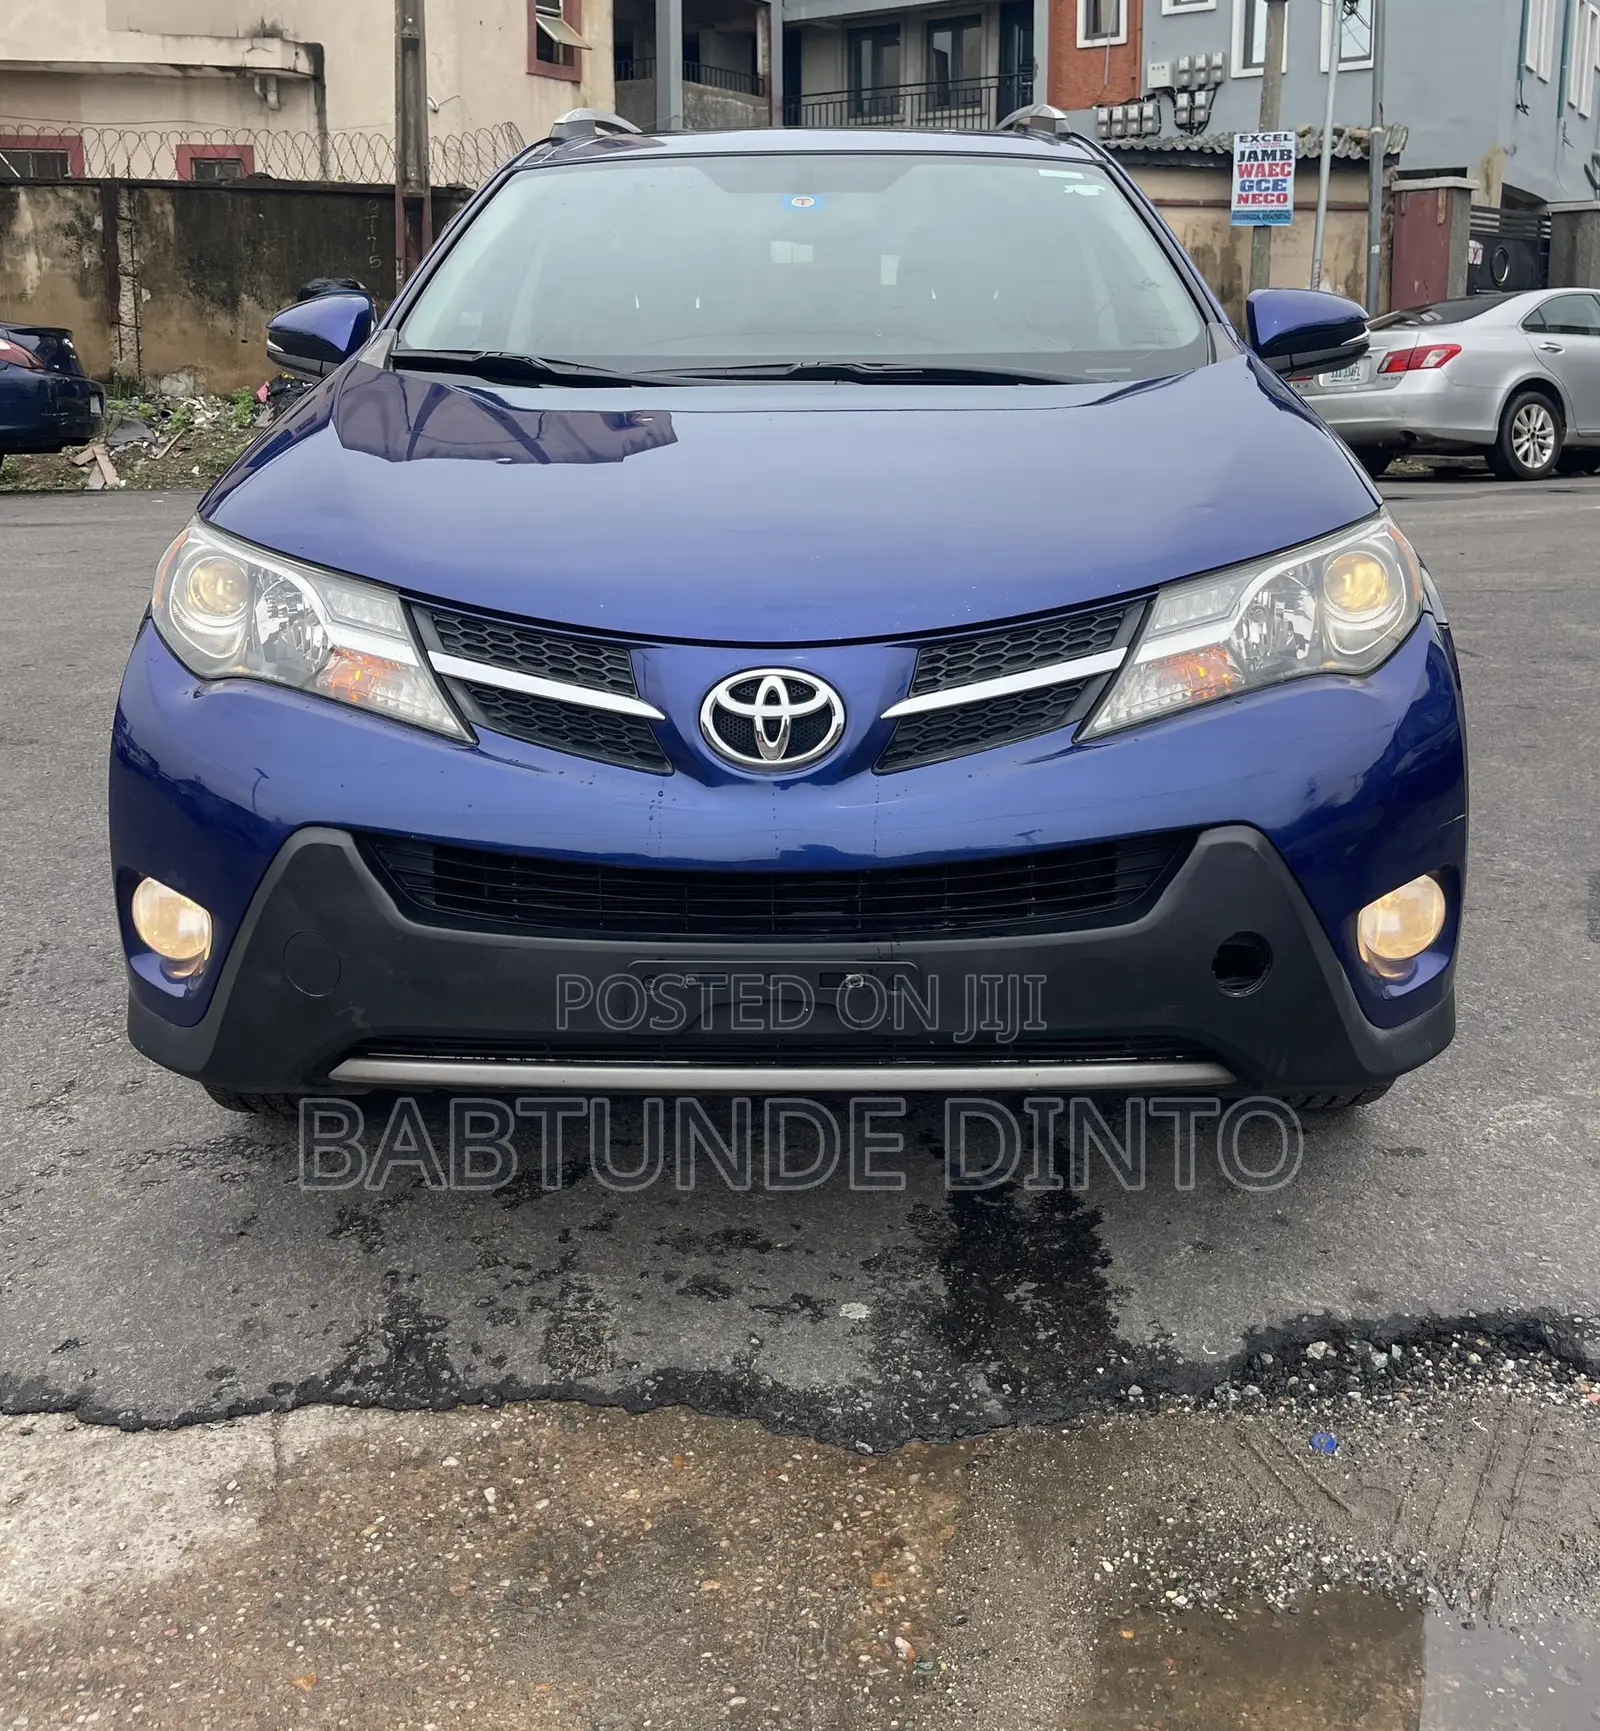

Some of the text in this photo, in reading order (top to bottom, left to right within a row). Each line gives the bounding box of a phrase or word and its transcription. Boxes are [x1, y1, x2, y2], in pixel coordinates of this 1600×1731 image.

[1239, 133, 1293, 143] EXCEL
[1237, 149, 1293, 162] JAMB
[1237, 162, 1292, 178] WAEC
[1239, 179, 1288, 192] GCE
[1236, 193, 1289, 205] NECO
